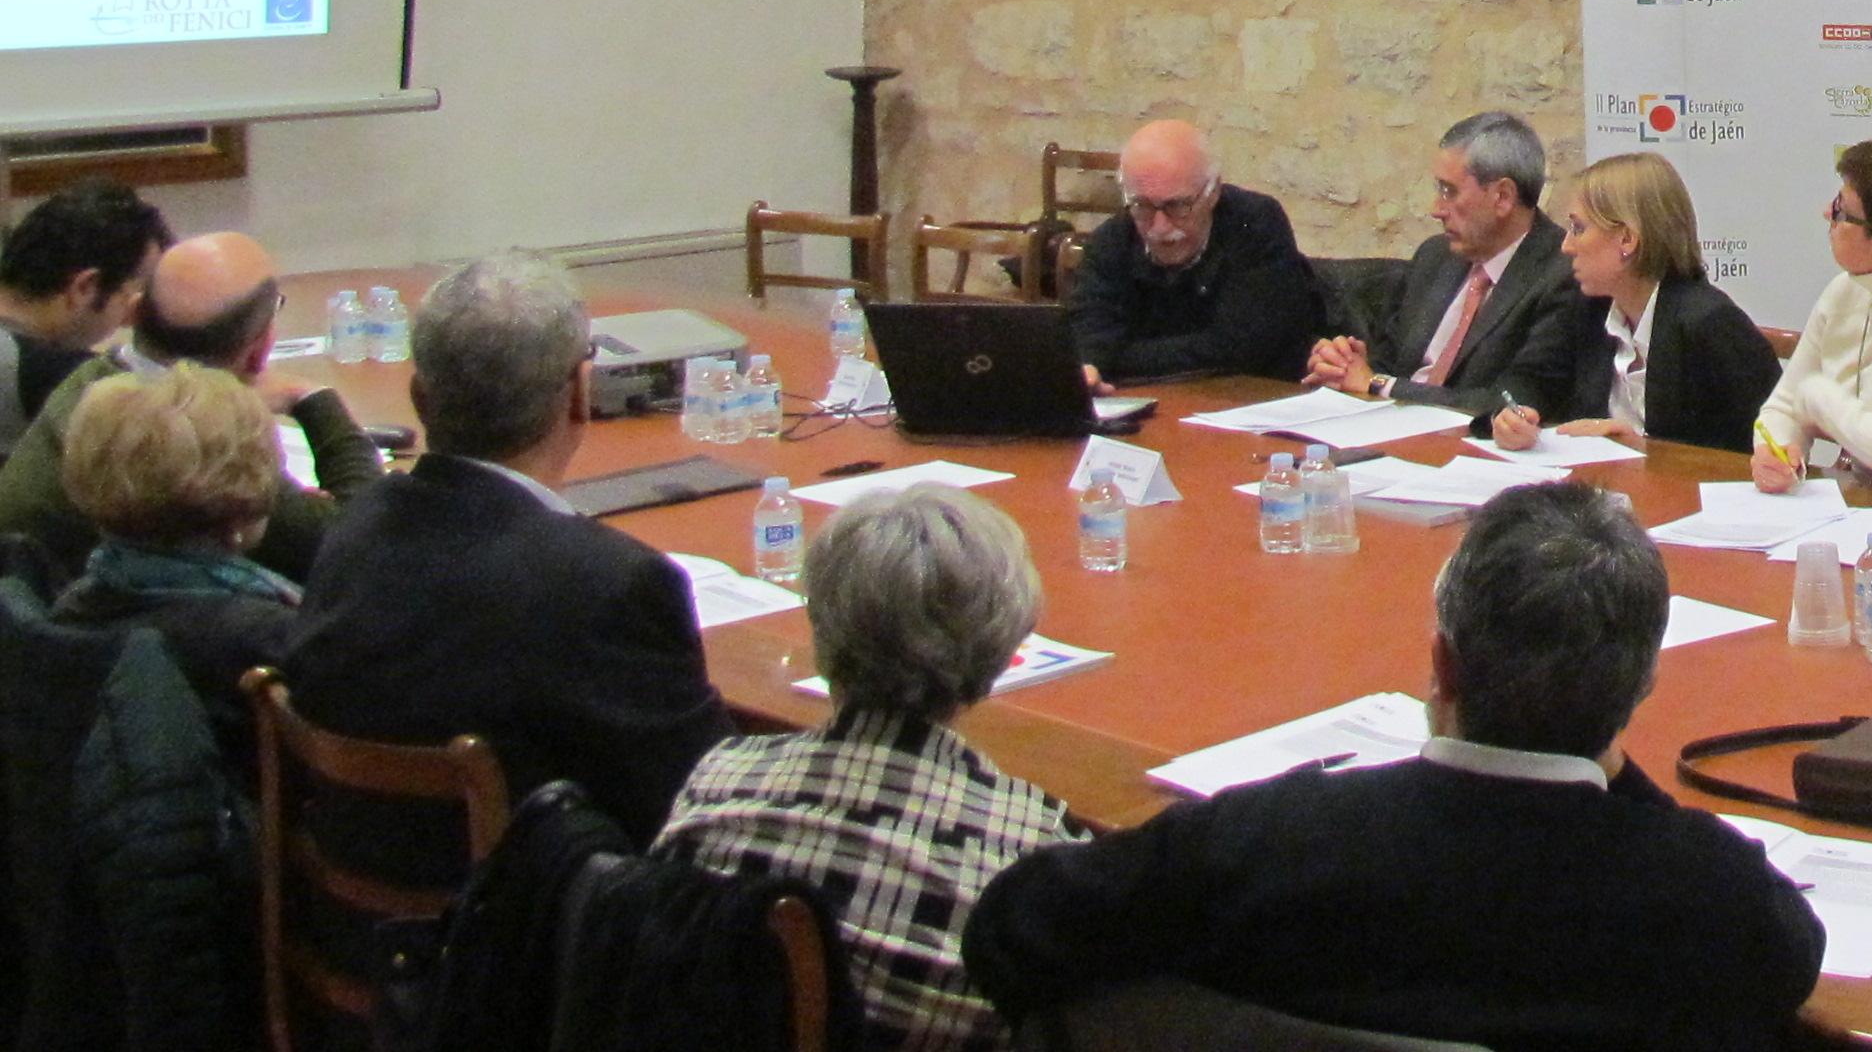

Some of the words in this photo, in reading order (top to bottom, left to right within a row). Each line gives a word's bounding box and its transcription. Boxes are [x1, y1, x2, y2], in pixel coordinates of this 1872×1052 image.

[169, 10, 252, 33] FENICI
[1596, 94, 1603, 113] II
[1608, 94, 1636, 115] Plan
[1689, 100, 1744, 116] Estratégico
[1689, 120, 1707, 140] de
[1711, 120, 1745, 144] Jaén
[1703, 237, 1748, 254] tratégico
[1714, 257, 1748, 282] Jaén
